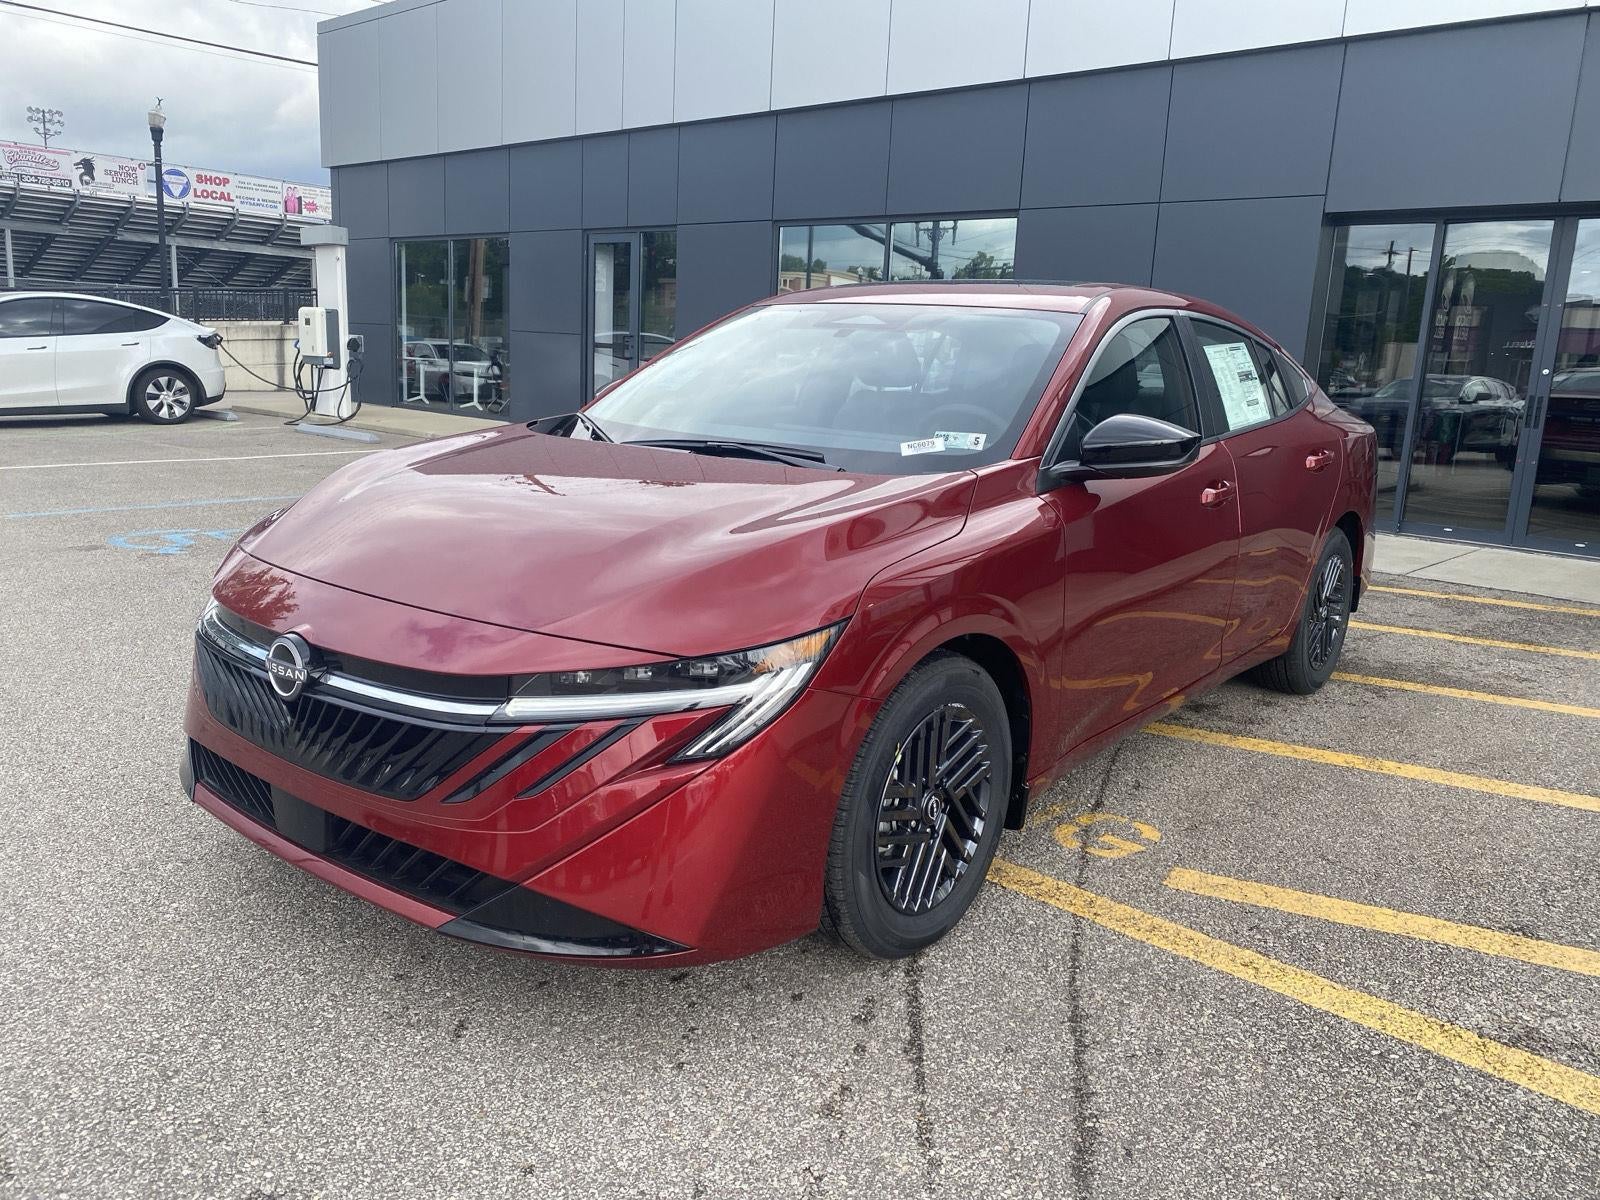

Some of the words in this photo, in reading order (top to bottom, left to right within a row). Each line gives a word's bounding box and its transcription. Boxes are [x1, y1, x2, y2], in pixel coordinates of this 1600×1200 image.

[104, 168, 138, 180] SERVING
[118, 164, 138, 173] NOW
[111, 176, 139, 186] LUNCH
[195, 174, 230, 187] SHOP
[193, 188, 235, 202] LOCAL
[973, 436, 980, 446] 5
[266, 660, 304, 681] ISSAN
